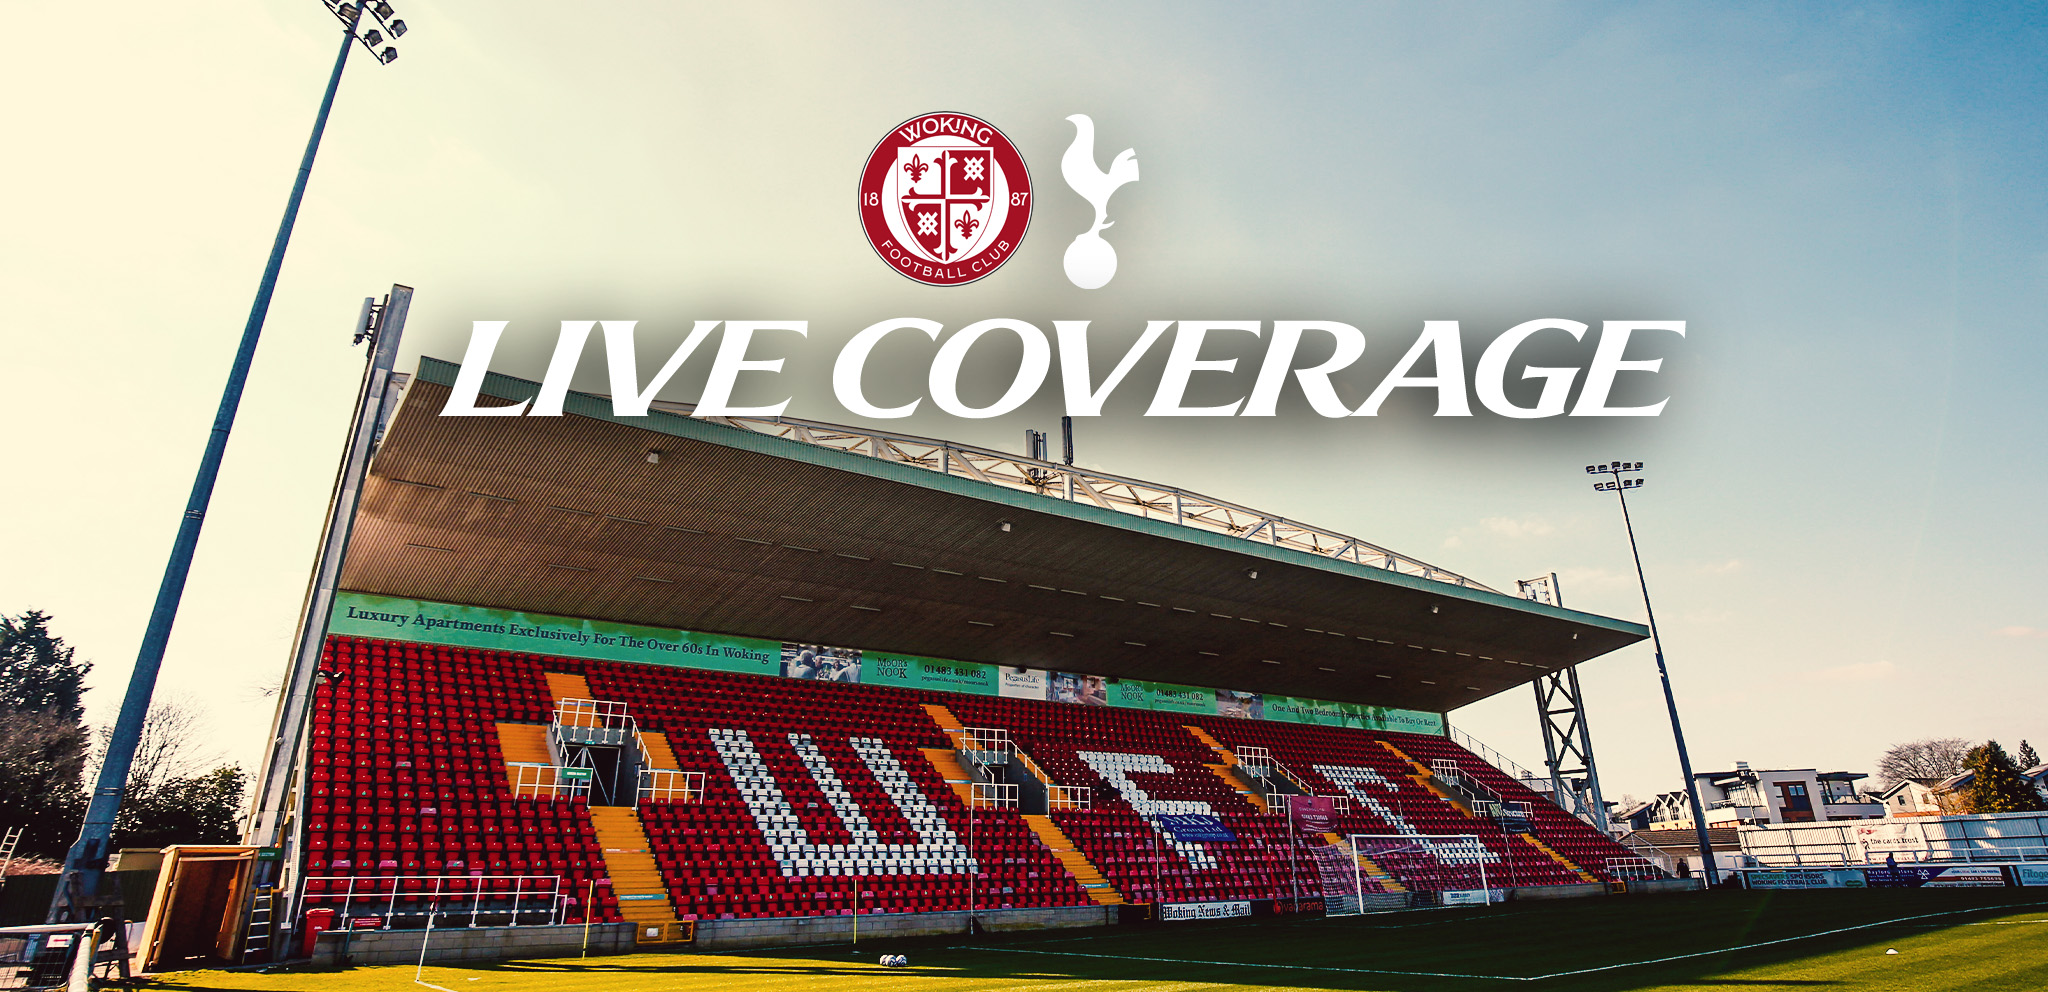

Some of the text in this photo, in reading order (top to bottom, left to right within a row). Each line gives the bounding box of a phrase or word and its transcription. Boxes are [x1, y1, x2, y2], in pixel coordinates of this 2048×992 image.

[346, 606, 770, 664] Luxury Apartments Exclusively For The Over 60s In Woking
[876, 666, 908, 679] NOOK
[924, 664, 987, 680] 01483 431 082
[1121, 691, 1144, 702] NOOK
[1156, 688, 1204, 701] 01483 431 082
[1272, 703, 1286, 712] One
[1286, 705, 1300, 714] And
[1301, 706, 1314, 715] Two
[1315, 707, 1341, 718] Bedroom
[1163, 903, 1252, 919] Woking News & Mail
